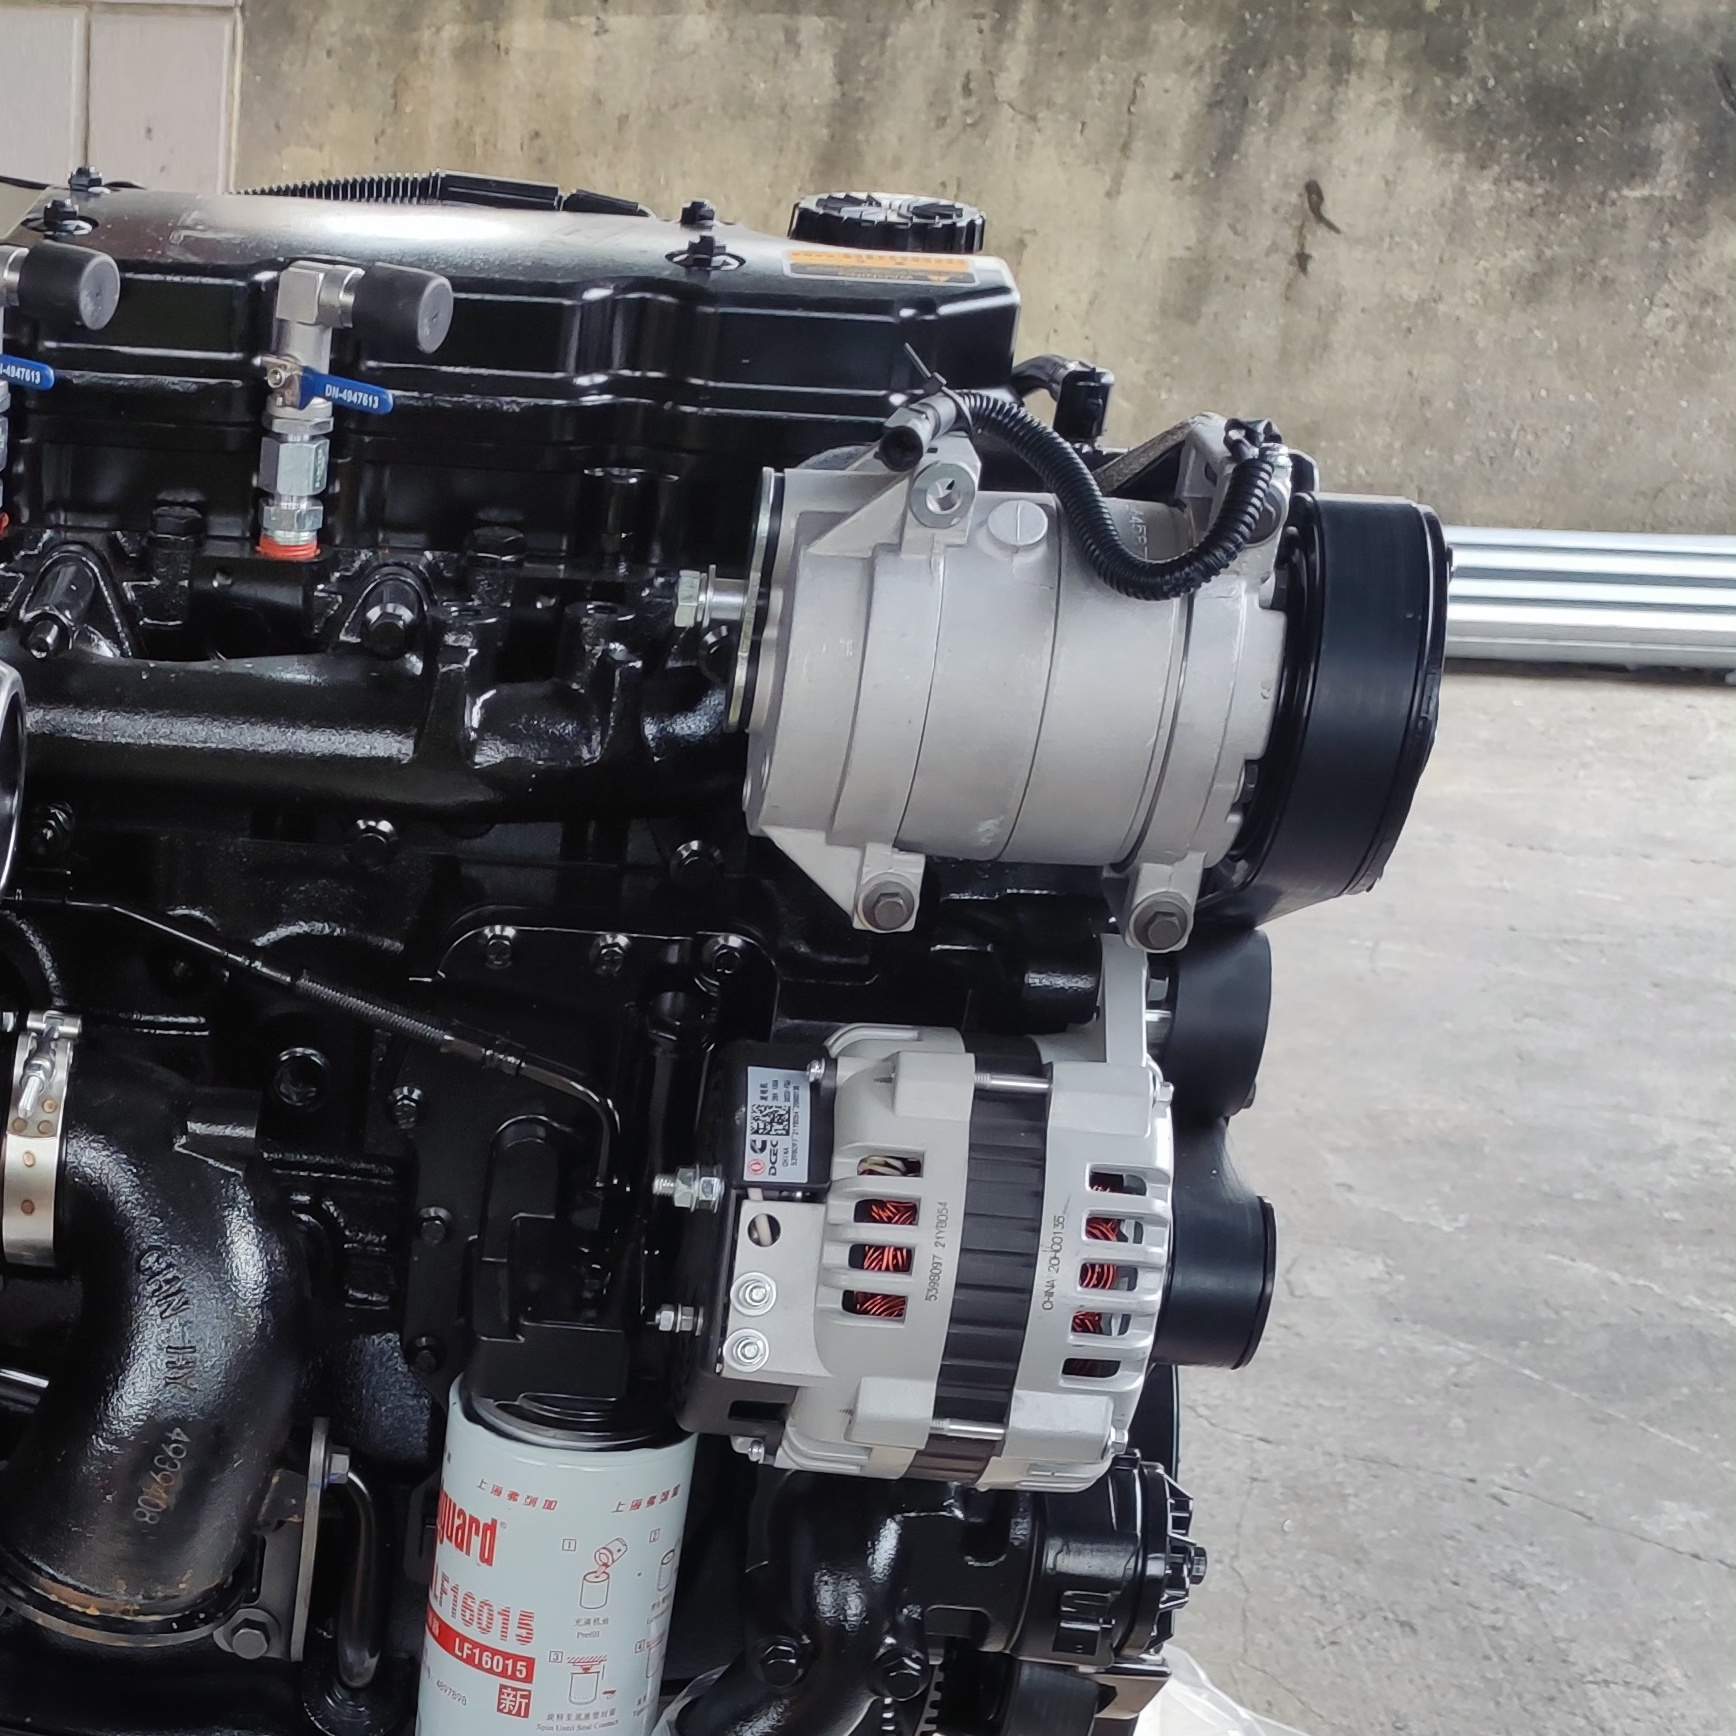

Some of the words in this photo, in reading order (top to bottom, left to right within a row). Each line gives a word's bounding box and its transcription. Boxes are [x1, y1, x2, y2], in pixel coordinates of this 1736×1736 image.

[925, 1254, 943, 1301] 5398097
[133, 1427, 192, 1524] 4939408
[454, 1637, 527, 1679] LF16015
[498, 1687, 530, 1717] 新
